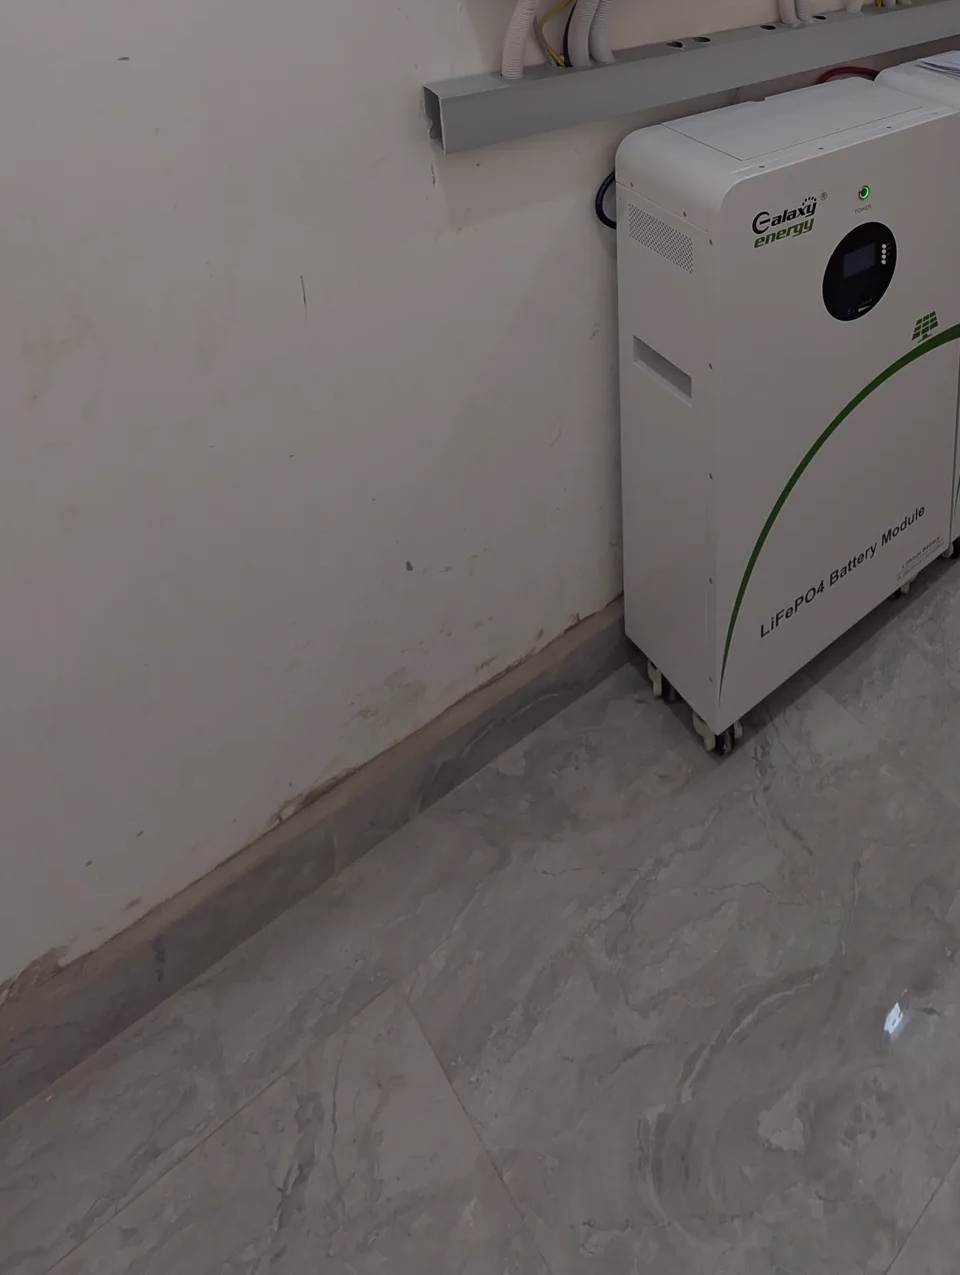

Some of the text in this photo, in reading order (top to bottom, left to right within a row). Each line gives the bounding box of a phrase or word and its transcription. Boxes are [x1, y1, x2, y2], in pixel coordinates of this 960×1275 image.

[752, 199, 818, 235] Galaxy
[854, 204, 872, 214] POWER
[754, 218, 815, 248] energy
[760, 580, 825, 638] LiFePO4
[829, 542, 878, 587] Battery
[881, 506, 925, 546] Module
